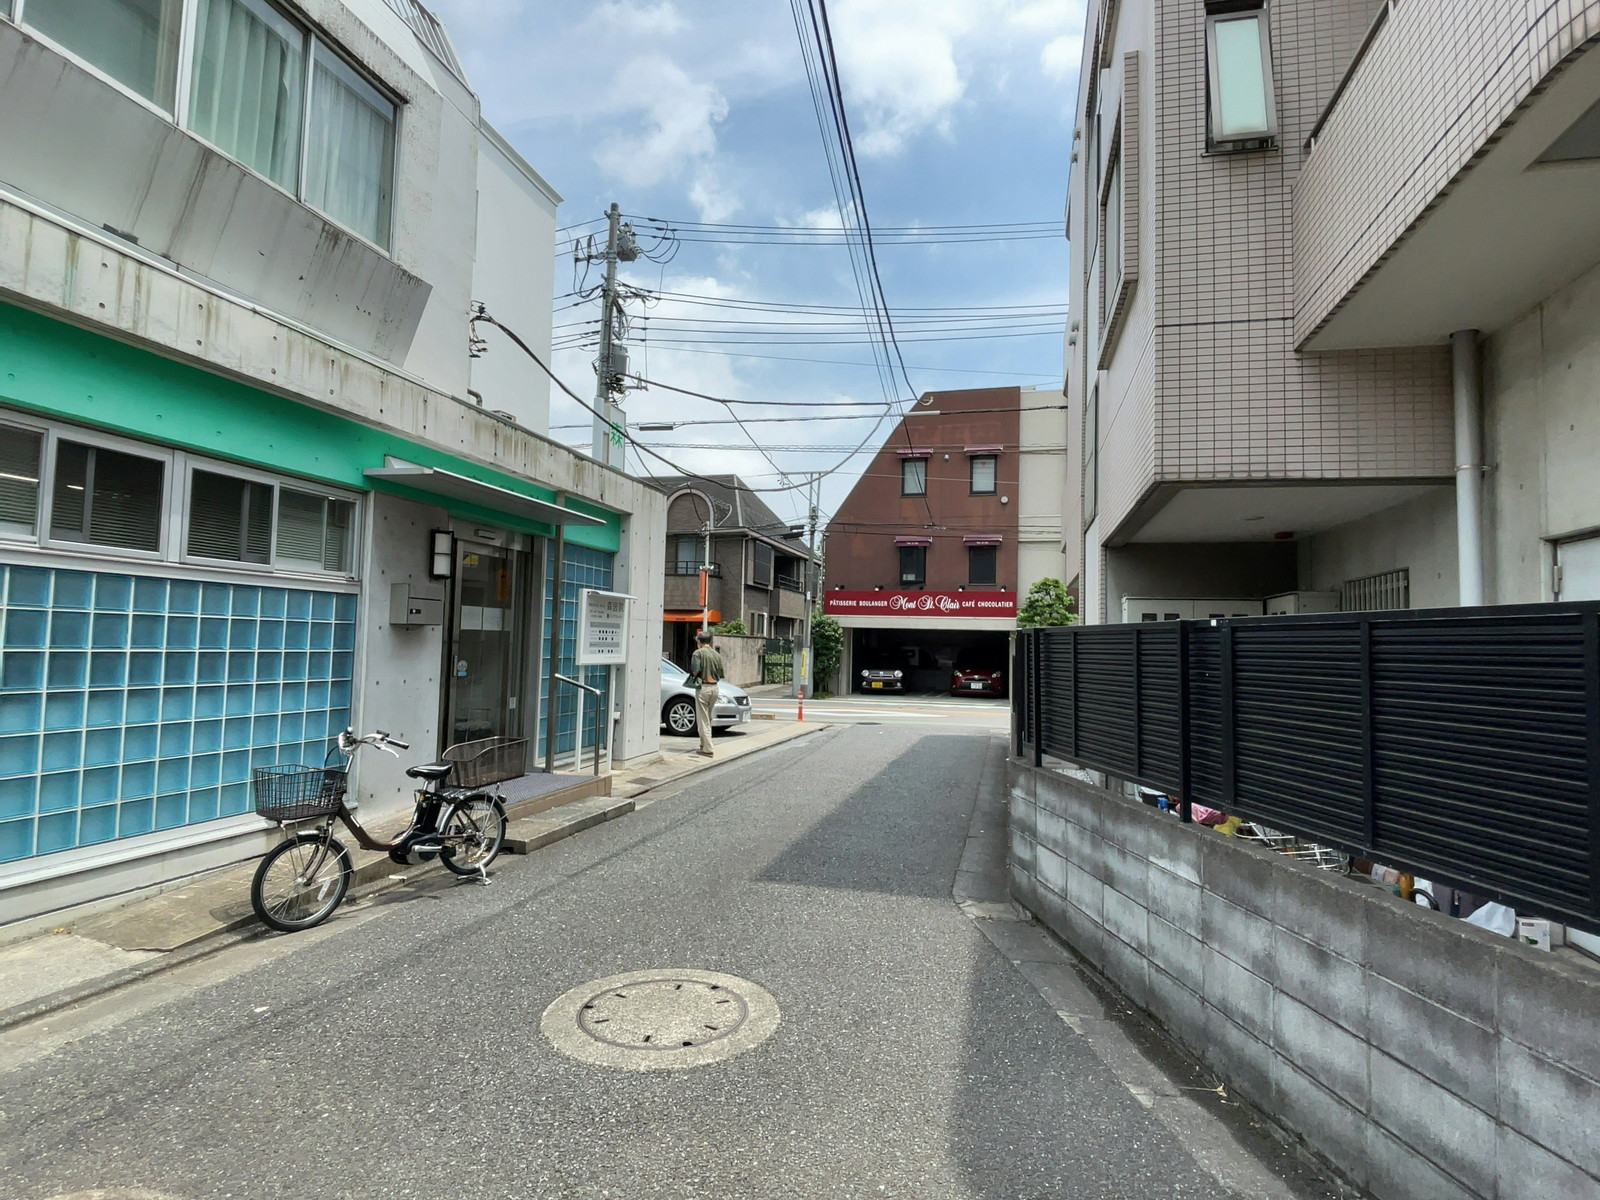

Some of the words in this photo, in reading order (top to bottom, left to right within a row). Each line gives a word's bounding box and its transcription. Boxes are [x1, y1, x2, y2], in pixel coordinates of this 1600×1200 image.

[889, 594, 917, 610] Mont
[935, 594, 960, 612] Clair
[961, 599, 975, 607] CAFÉ
[977, 600, 1014, 608] CHOCOLATIER
